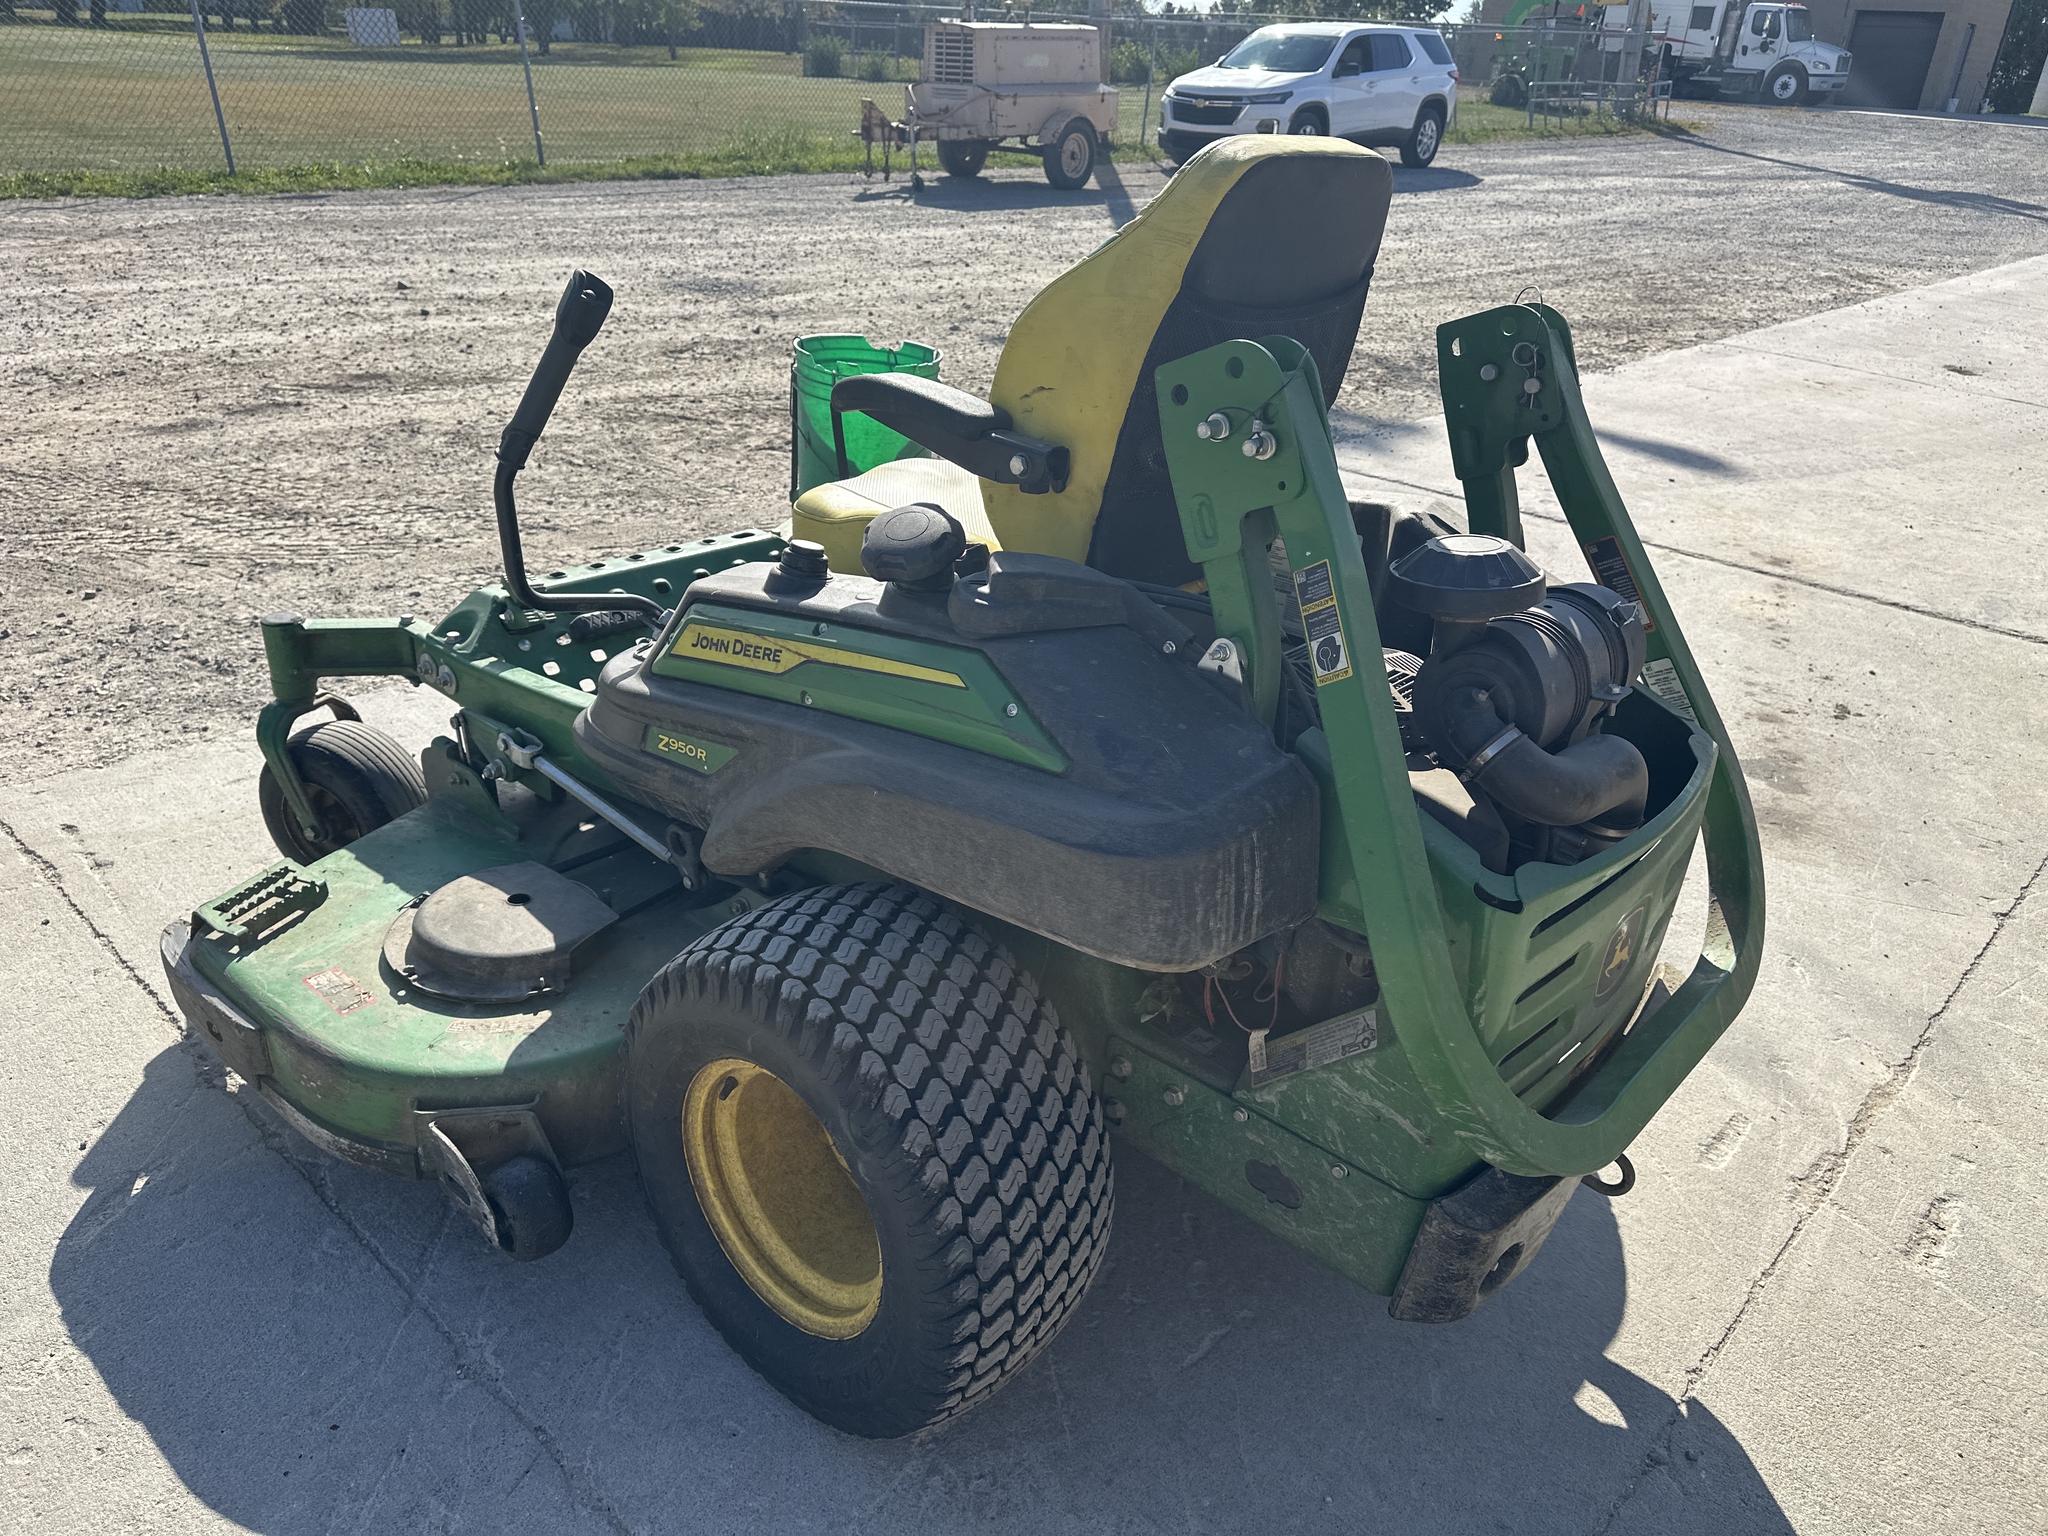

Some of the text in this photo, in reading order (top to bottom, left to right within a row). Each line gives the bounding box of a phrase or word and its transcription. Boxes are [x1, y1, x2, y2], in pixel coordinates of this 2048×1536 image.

[691, 632, 782, 663] JOHN DEERE
[1319, 671, 1345, 684] CAUTION
[657, 734, 707, 762] Z950R
